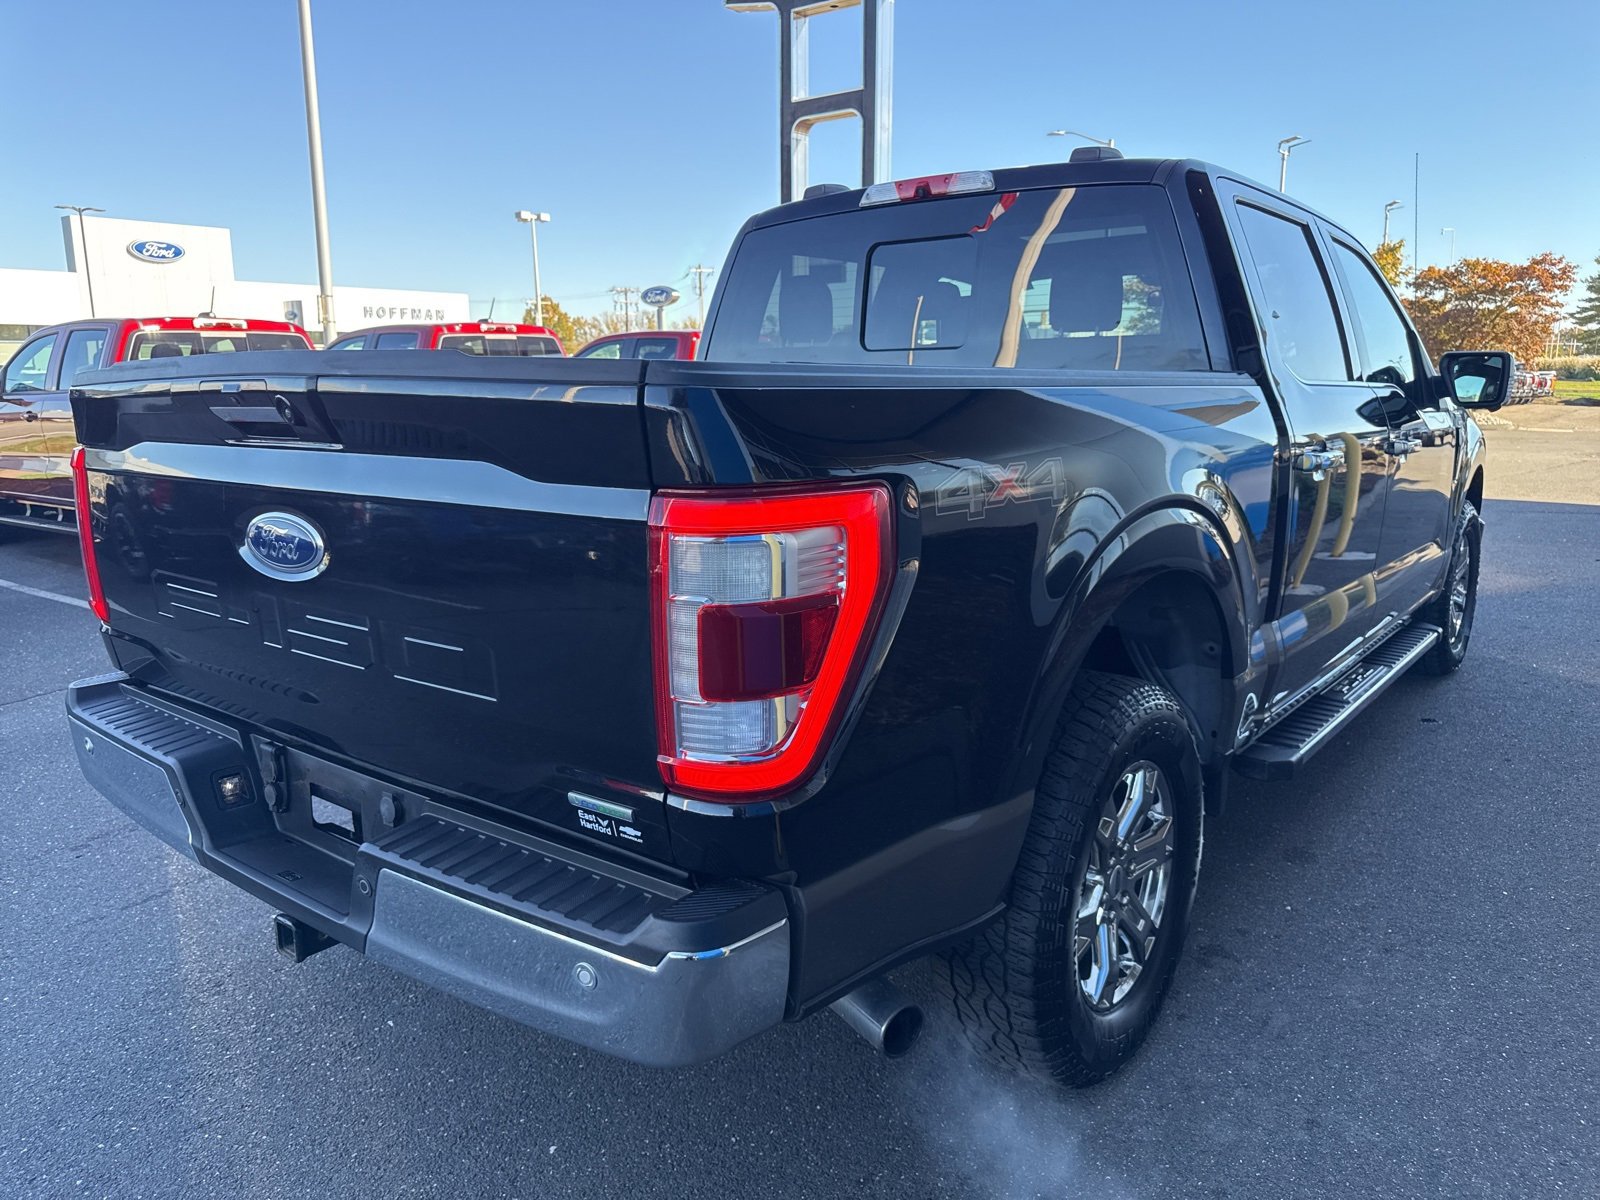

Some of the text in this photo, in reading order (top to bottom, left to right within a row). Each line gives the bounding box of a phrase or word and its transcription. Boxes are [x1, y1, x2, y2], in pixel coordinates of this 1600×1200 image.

[142, 242, 175, 257] Ford
[363, 306, 445, 321] HOFFMAN
[260, 524, 299, 560] Ford
[577, 809, 597, 822] East
[579, 818, 612, 835] Hartford
